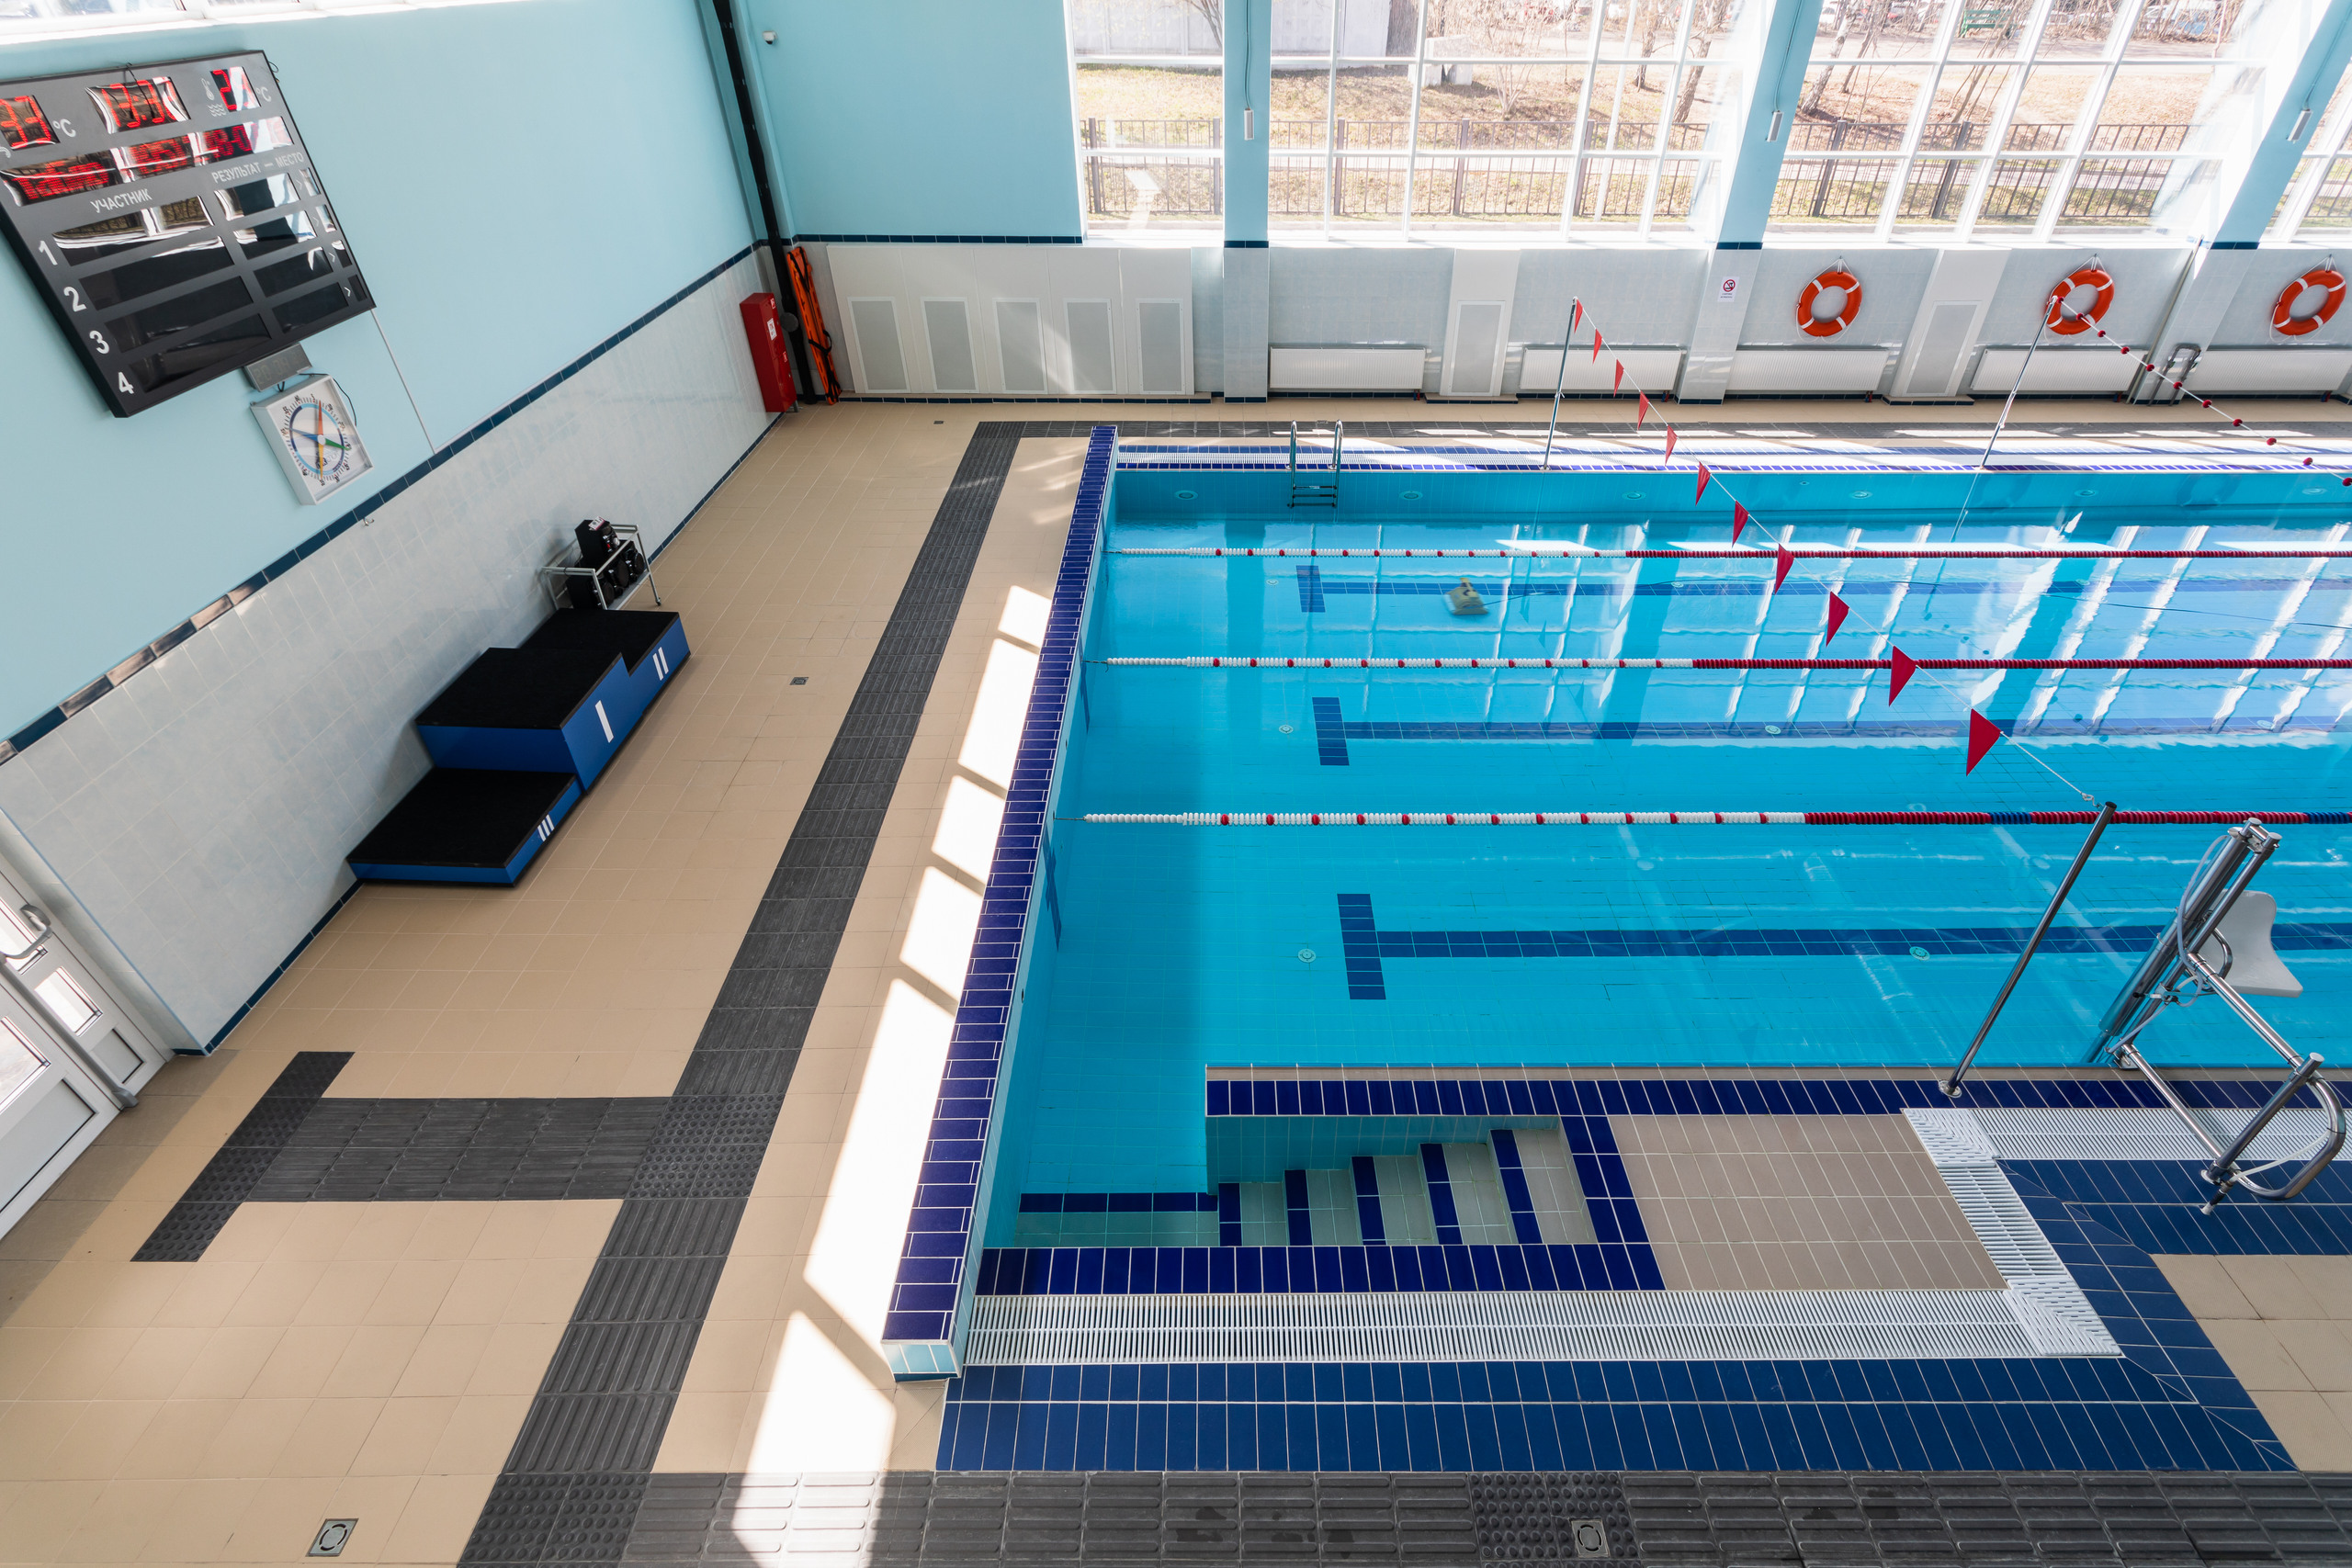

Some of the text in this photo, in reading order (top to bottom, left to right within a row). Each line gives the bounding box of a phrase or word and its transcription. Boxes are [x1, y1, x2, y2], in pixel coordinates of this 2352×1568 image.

[211, 162, 262, 184] РЕЗУЛЬТАТ
[276, 152, 304, 168] МЕСТО
[90, 188, 153, 213] УЧАСТНИК
[39, 240, 58, 265] 1
[63, 287, 87, 312] 2
[89, 330, 110, 355] 3
[118, 371, 134, 394] 4
